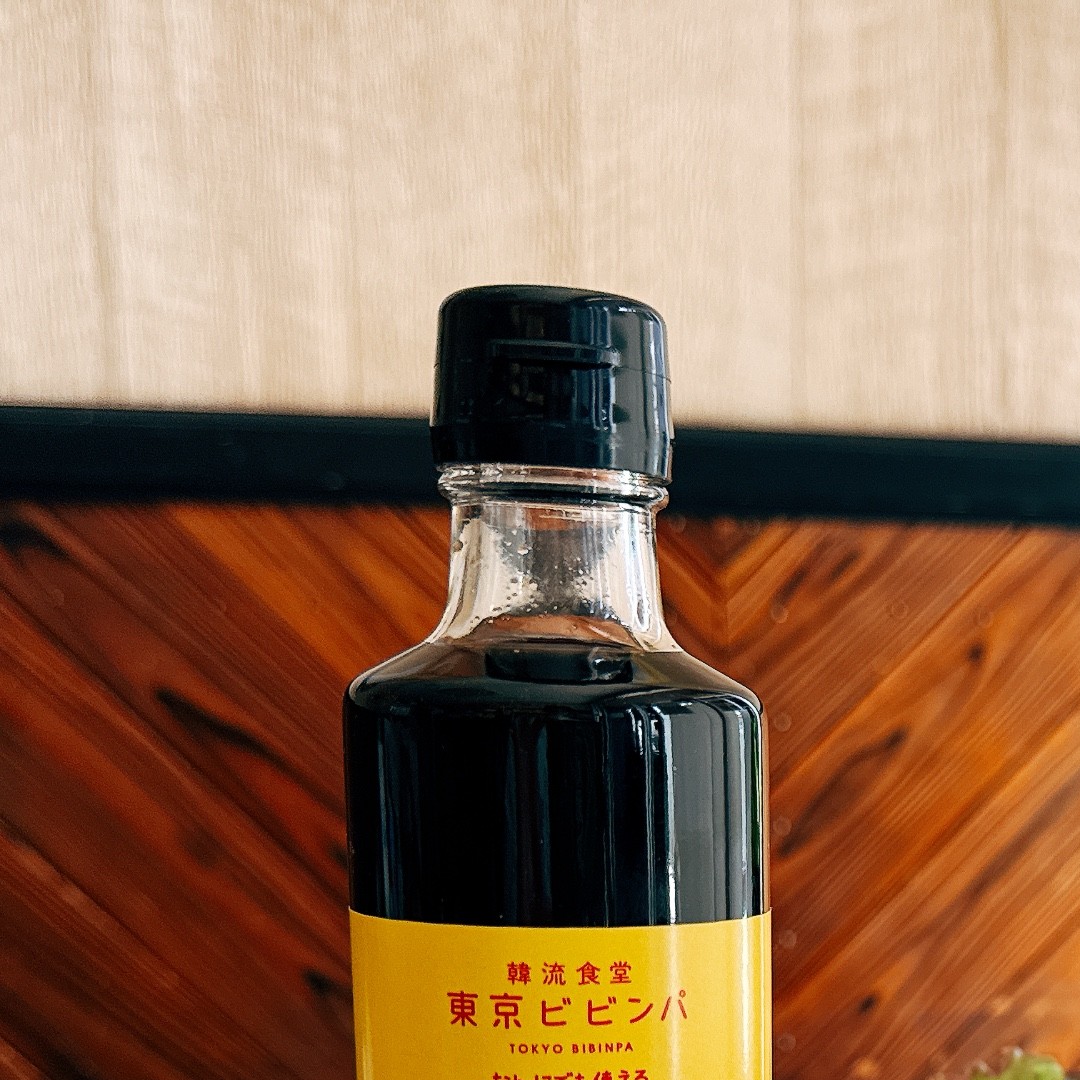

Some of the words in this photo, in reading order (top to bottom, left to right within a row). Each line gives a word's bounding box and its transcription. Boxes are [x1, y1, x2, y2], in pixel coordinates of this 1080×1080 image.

[506, 960, 632, 986] 韓流食堂
[446, 989, 687, 1030] 東京ビビンパ
[509, 1042, 563, 1055] TOKYO
[571, 1041, 634, 1054] BIBINPA
